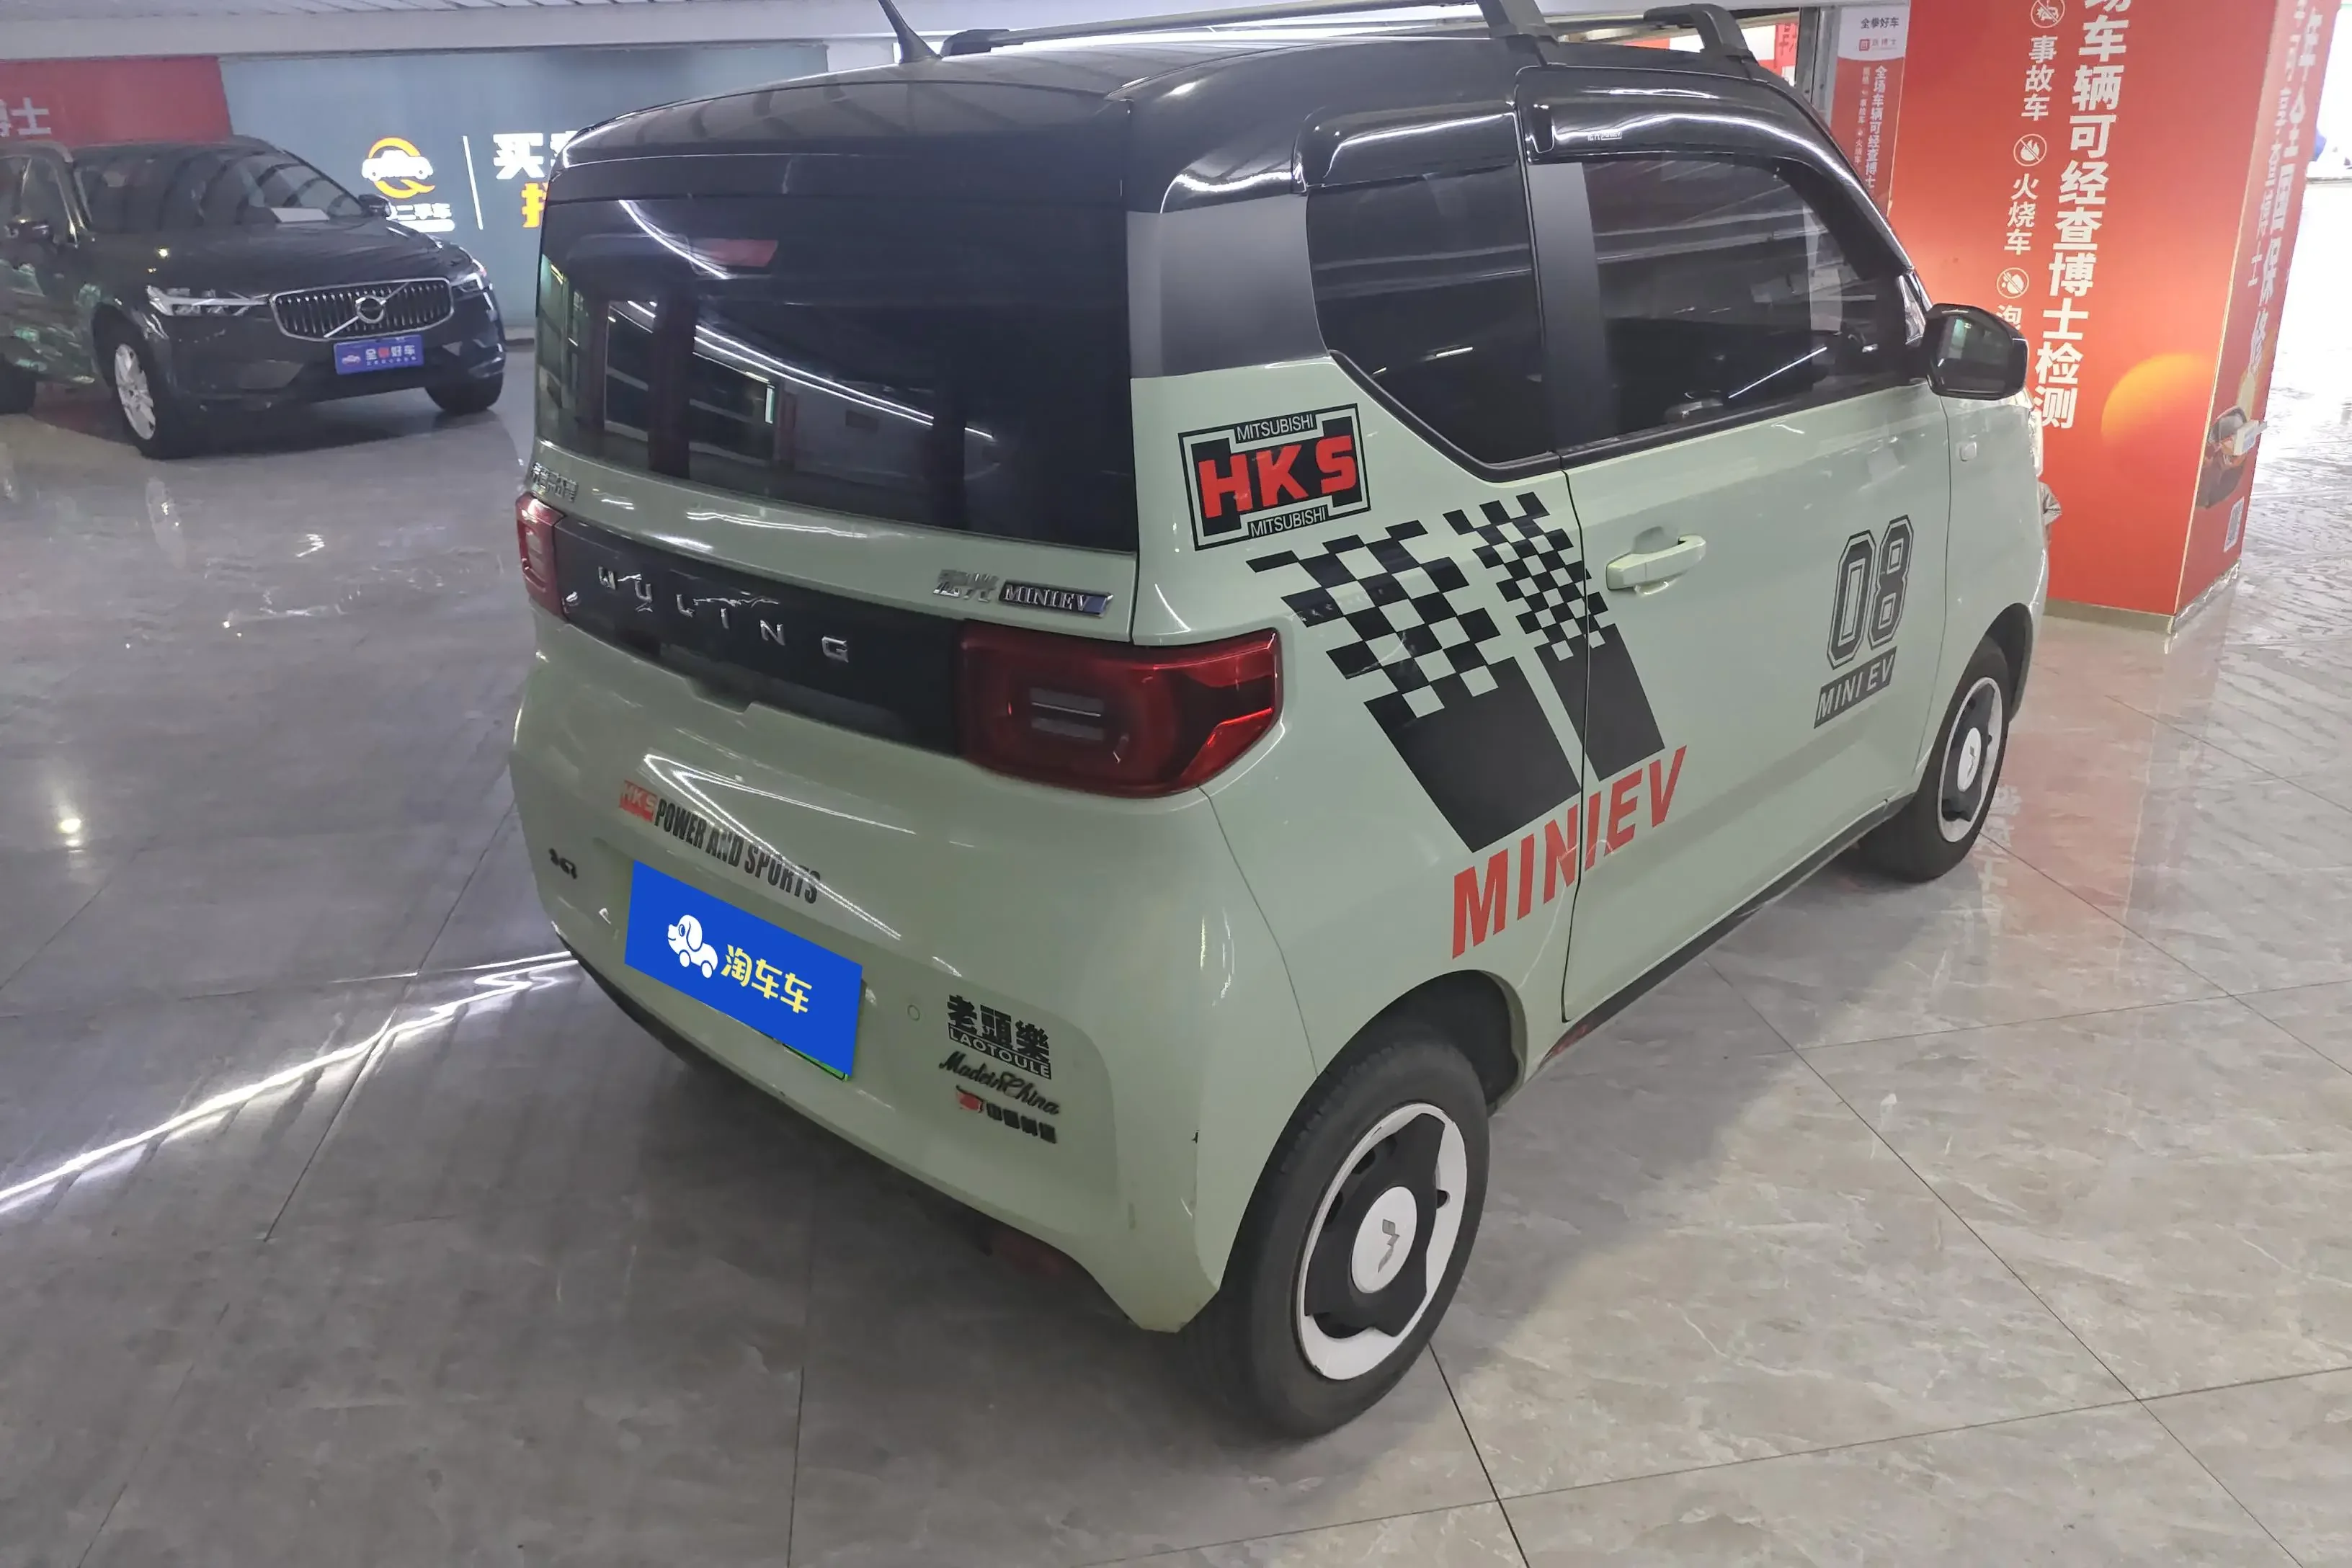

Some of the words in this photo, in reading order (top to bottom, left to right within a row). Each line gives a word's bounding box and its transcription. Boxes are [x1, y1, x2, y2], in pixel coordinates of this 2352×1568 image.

[2021, 35, 2058, 121] 事故车
[2004, 173, 2039, 255] 火烧车
[2033, 0, 2133, 429] 车辆可经查博士检测
[1237, 414, 1314, 441] MITSUBISHI
[1198, 435, 1357, 519] HKS
[1250, 507, 1327, 538] MITSUBISHI
[1827, 514, 1914, 670] 08
[654, 798, 708, 850] POWER
[705, 826, 745, 868] AND
[744, 842, 821, 905] SPORTS
[1452, 744, 1688, 960] MINIEV
[949, 1027, 1051, 1079] LAOTOULE
